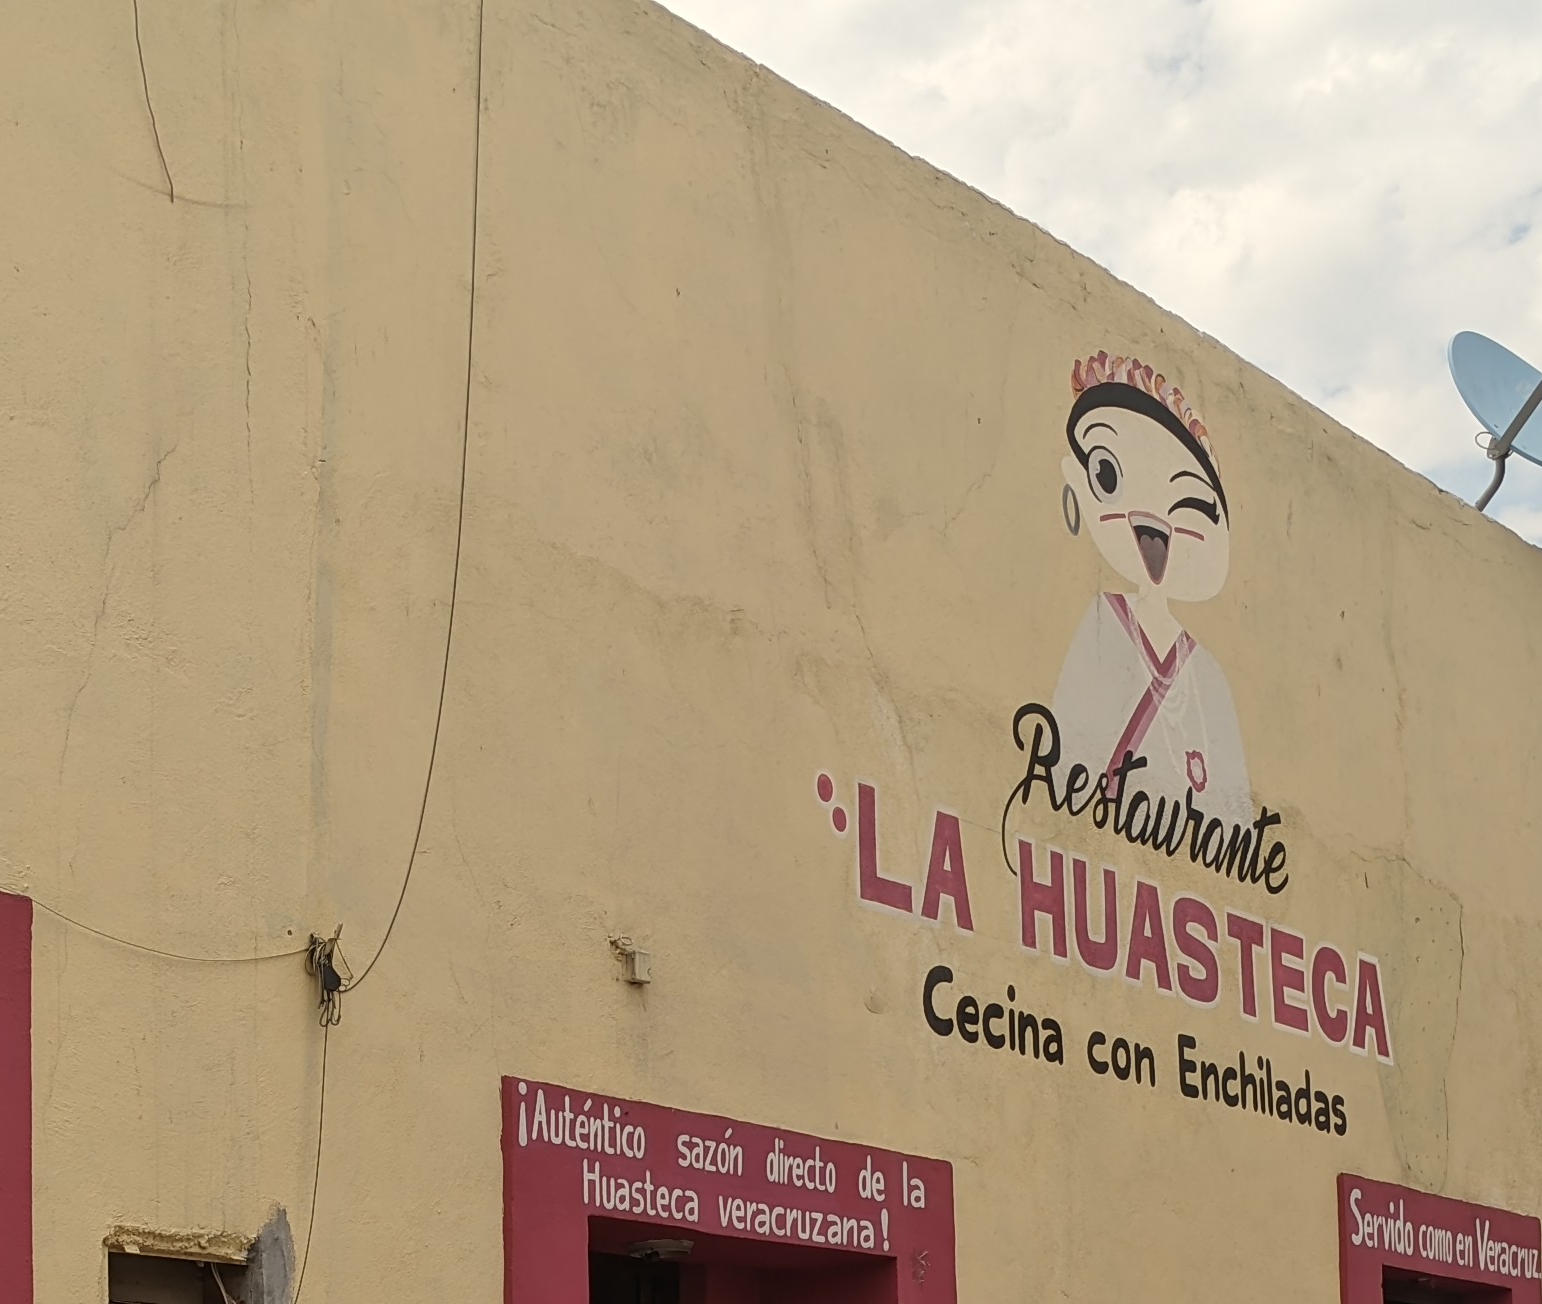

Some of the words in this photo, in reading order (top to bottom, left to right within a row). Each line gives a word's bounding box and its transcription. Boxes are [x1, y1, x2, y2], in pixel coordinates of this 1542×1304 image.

[1002, 702, 1289, 895] Restaurante
[857, 781, 975, 932] LA
[1016, 837, 1392, 1060] HUASTECA
[922, 965, 1064, 1066] Cecina
[1086, 1029, 1157, 1087] con
[1176, 1033, 1348, 1136] Enchiladas
[517, 1081, 646, 1159] ¡Auténtico
[677, 1128, 743, 1176] sazón
[766, 1137, 837, 1194] directo
[858, 1155, 886, 1202] de
[902, 1161, 926, 1209] la
[582, 1158, 699, 1223] Huasteca
[718, 1195, 890, 1252] veracruzana!
[1349, 1188, 1414, 1256] Servido
[1418, 1224, 1453, 1264] como
[1455, 1232, 1473, 1267] en
[1475, 1217, 1542, 1279] Veracruz.
